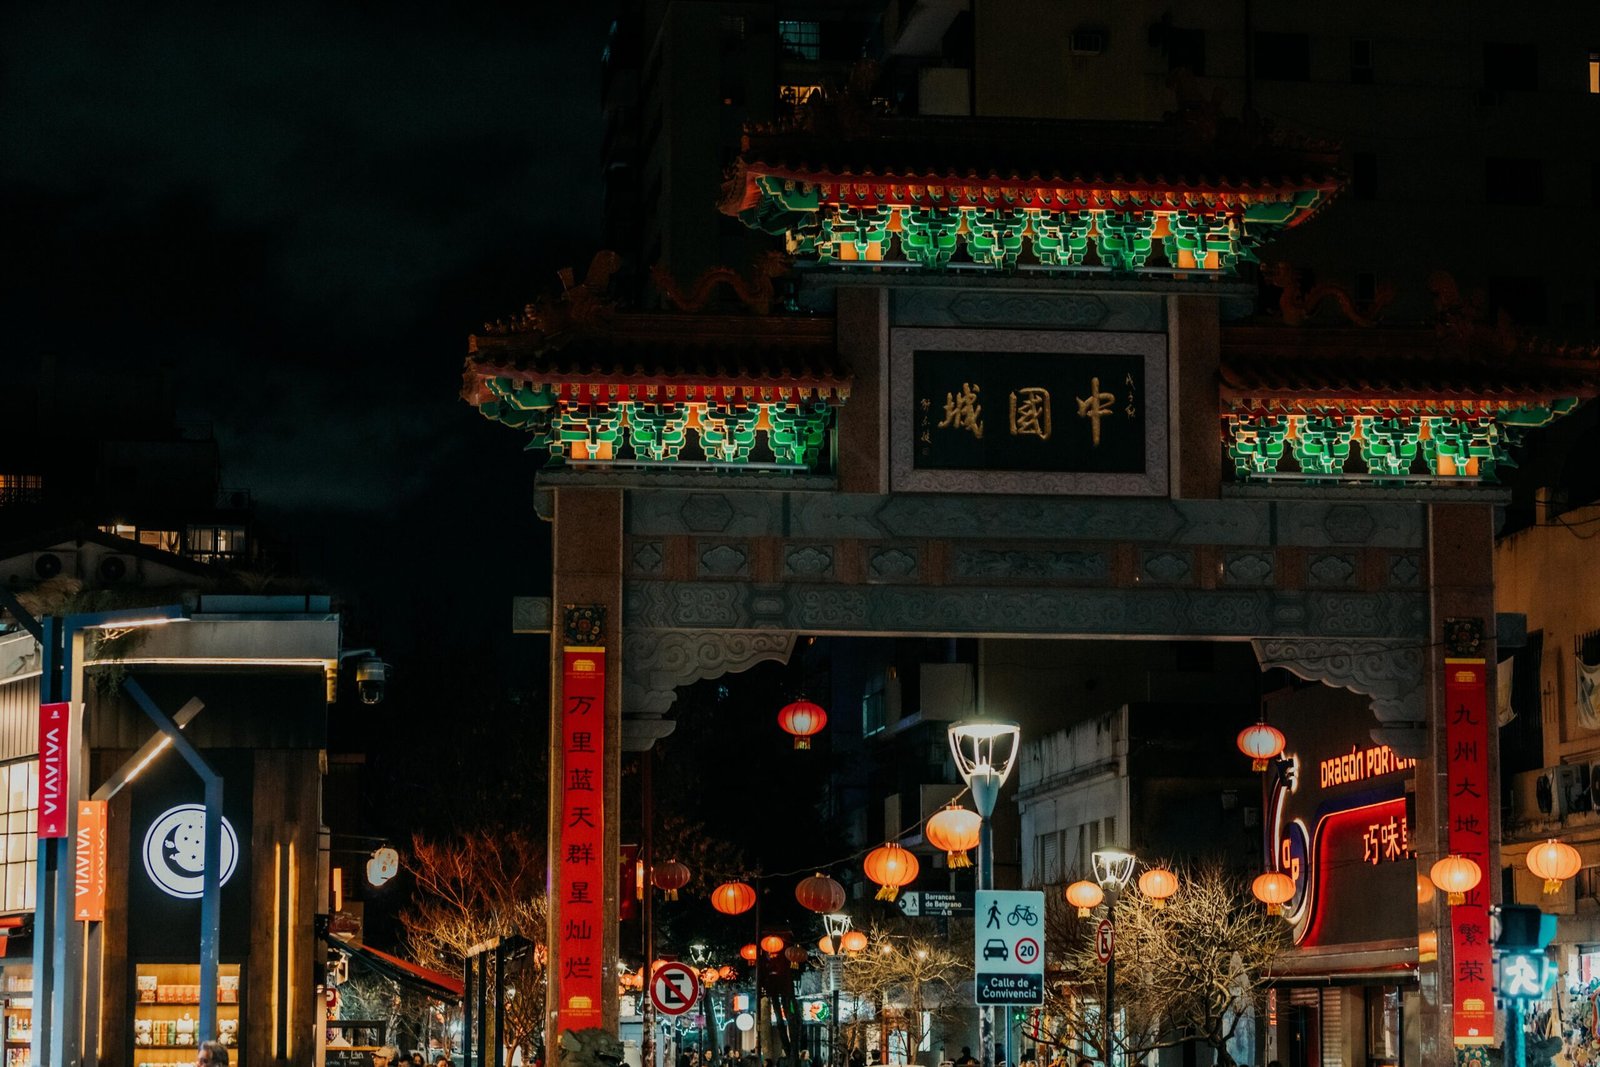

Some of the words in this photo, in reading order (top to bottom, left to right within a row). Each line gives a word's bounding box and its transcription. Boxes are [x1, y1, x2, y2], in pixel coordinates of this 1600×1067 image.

[44, 728, 59, 815] VIAVIVA
[565, 696, 596, 980] 万里蓝天群星灿烂
[1452, 703, 1485, 982] 九州大地业繁荣
[75, 827, 90, 897] VIAVIVA
[925, 893, 956, 901] Barrancas
[934, 901, 962, 910] Belgrano
[1020, 945, 1035, 957] 20
[664, 973, 685, 1004] E
[982, 988, 1037, 998] Convivencia
[990, 977, 1015, 988] Calle
[1017, 978, 1029, 988] de
